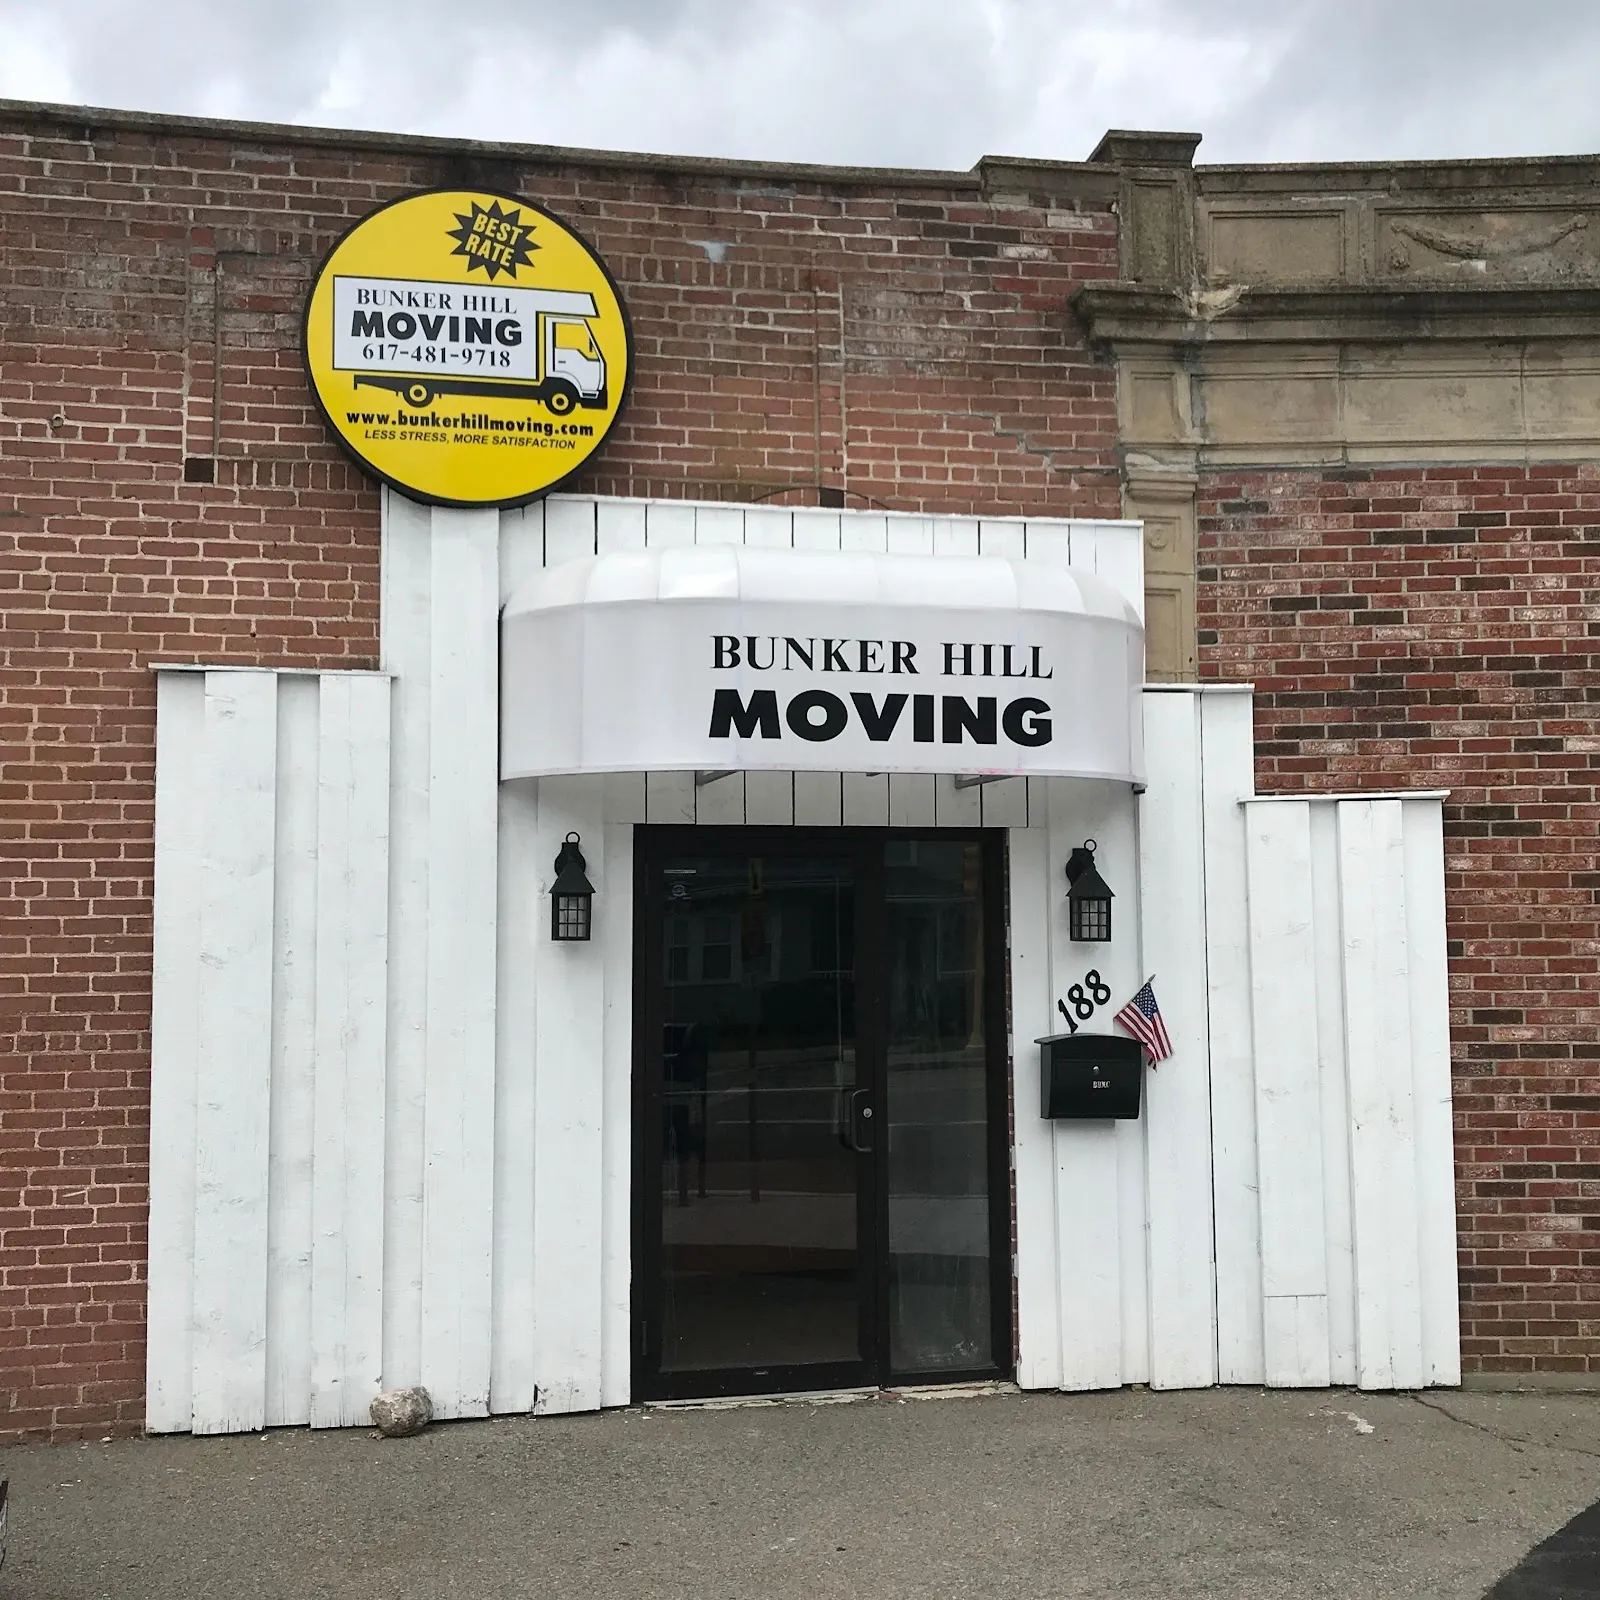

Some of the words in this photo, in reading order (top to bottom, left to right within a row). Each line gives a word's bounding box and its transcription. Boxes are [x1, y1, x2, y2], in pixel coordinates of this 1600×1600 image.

[472, 213, 524, 245] BEST
[464, 234, 515, 267] RATE
[356, 288, 452, 310] BUNKER
[463, 294, 517, 314] HILL
[351, 310, 522, 347] MOVING
[362, 343, 511, 368] 617-481-9718
[346, 410, 594, 437] www.bunkerhillmoving.com
[364, 429, 397, 441] LESS
[399, 430, 450, 444] STRESS,
[453, 433, 489, 445] MORE
[491, 434, 576, 450] SATISFACTION
[709, 635, 920, 674] BUNKER
[940, 642, 1054, 679] HILL
[708, 688, 1053, 747] MOVING
[1057, 969, 1111, 1034] 188
